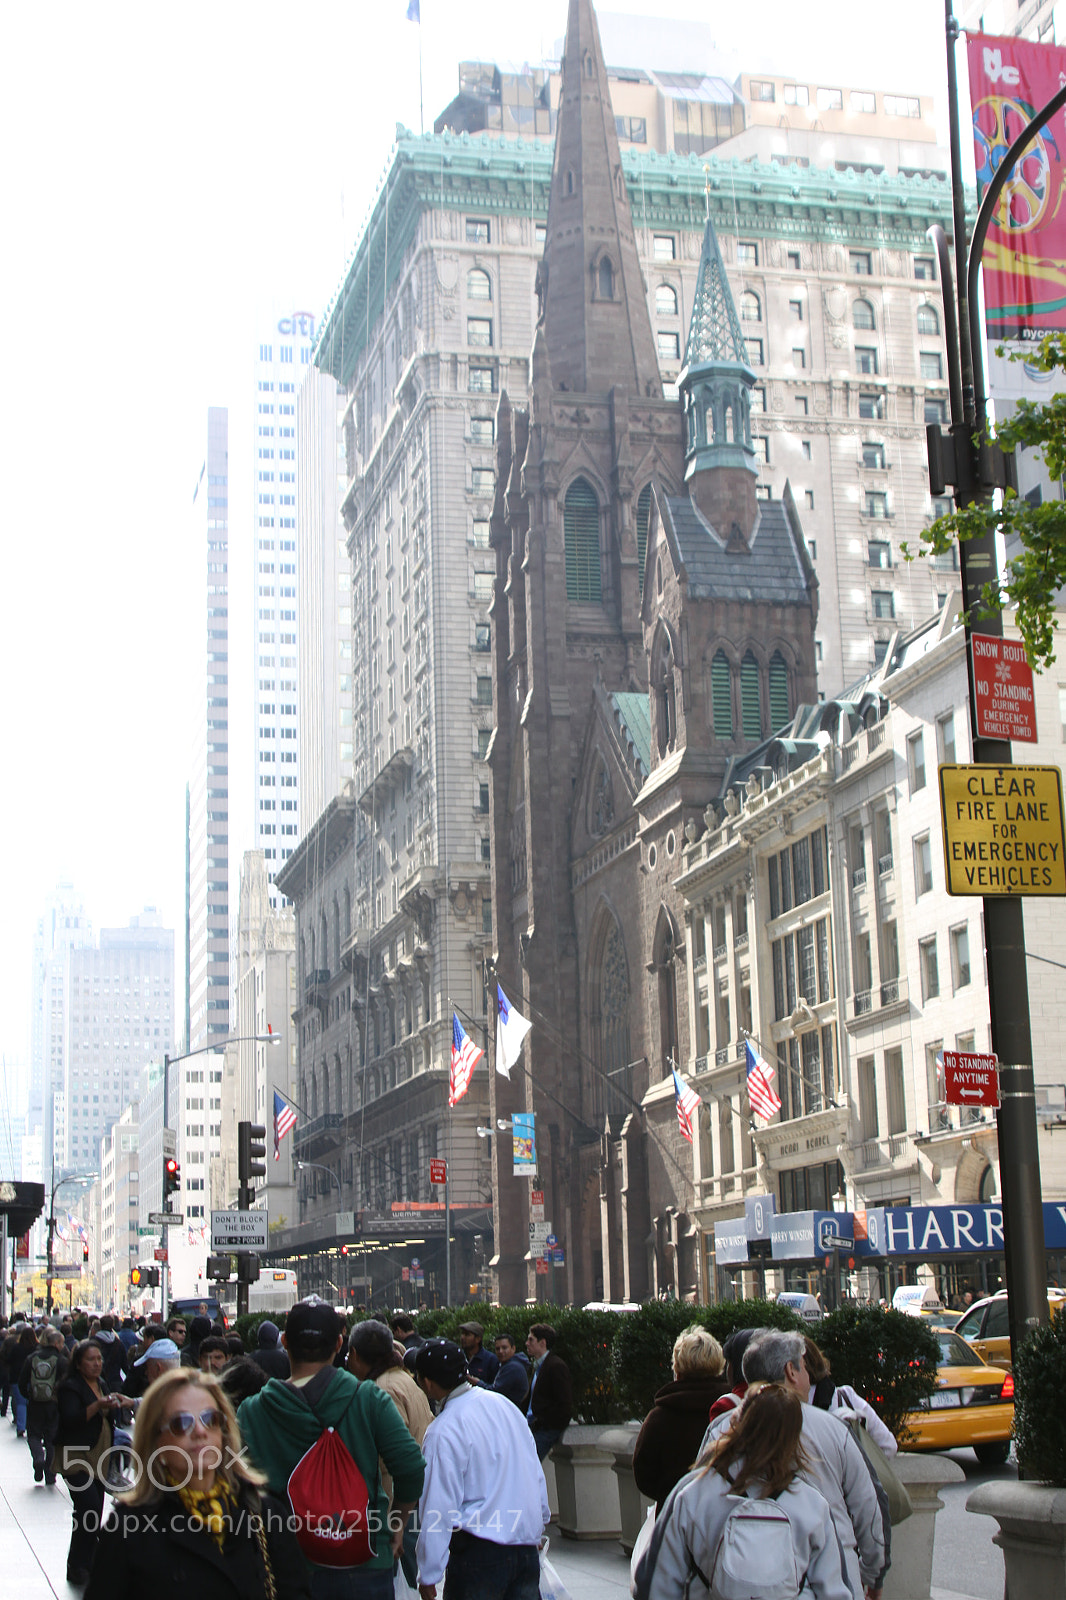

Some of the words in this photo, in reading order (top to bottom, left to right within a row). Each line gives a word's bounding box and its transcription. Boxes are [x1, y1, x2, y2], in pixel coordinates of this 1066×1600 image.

[278, 311, 315, 337] citi
[975, 641, 998, 659] SNOW
[977, 680, 989, 696] NO
[993, 683, 1032, 702] STANDING
[992, 699, 1020, 712] DURING
[984, 710, 1029, 725] EMERGENCY
[983, 721, 1010, 735] VEHICLES
[1012, 725, 1031, 738] TOWED
[967, 777, 1036, 797] CLEAR
[956, 802, 997, 820] FIRE
[1005, 802, 1049, 821] LANE
[993, 824, 1018, 839] FOR
[952, 842, 1059, 861] EMERGENCY
[965, 867, 1052, 886] VEHICLES
[946, 1056, 957, 1068] NO
[959, 1057, 994, 1071] STANDING
[953, 1072, 990, 1085] ANYTIME
[771, 1231, 789, 1244] HARRY
[789, 1229, 813, 1242] WINSTON
[886, 1209, 1005, 1251] HARR
[314, 1528, 352, 1540] adidas
